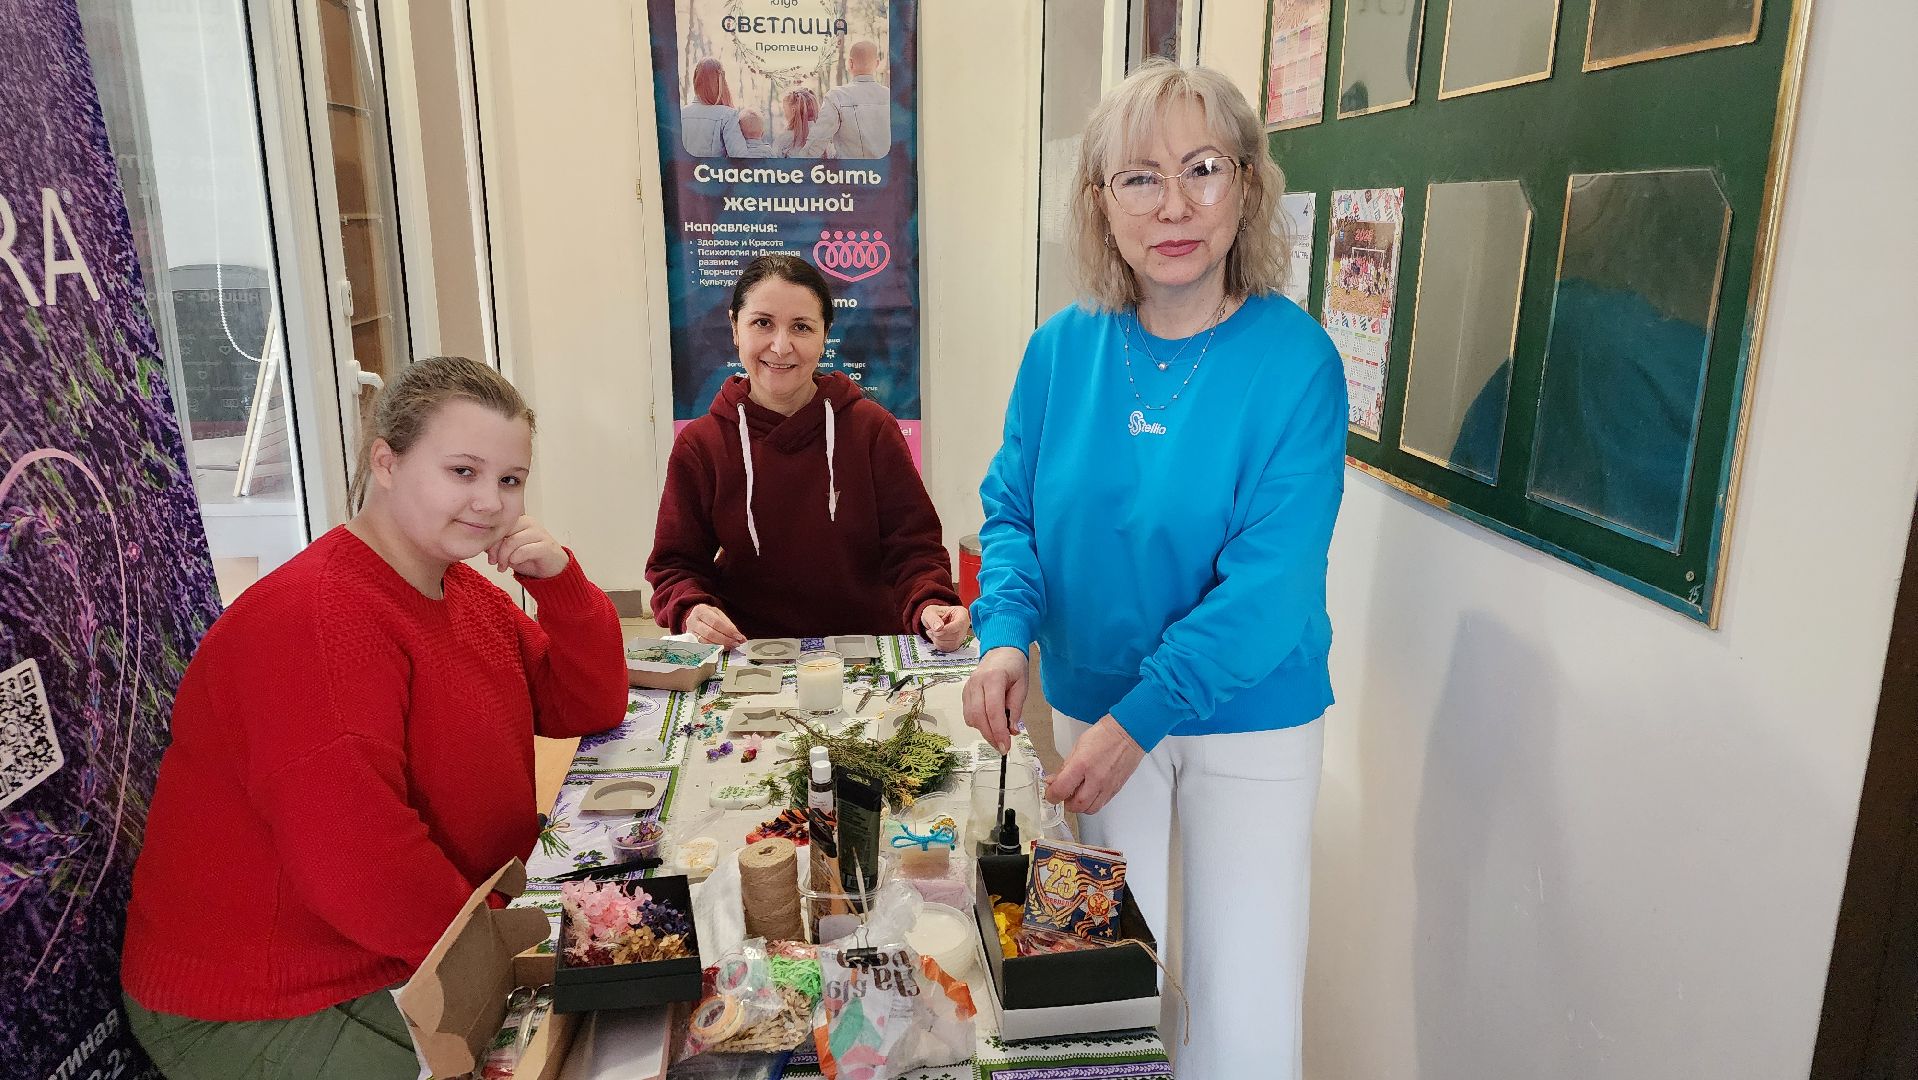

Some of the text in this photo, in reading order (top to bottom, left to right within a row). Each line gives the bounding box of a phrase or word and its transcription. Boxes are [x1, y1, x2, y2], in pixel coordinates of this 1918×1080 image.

[721, 15, 848, 37] СВЕТЛИЦА
[755, 42, 818, 53] Протвино
[693, 164, 882, 185] Счастье быть
[723, 192, 854, 214] женщиной
[684, 221, 778, 235] Направления:
[697, 238, 739, 247] Здоровье
[749, 239, 783, 247] Красота
[698, 249, 749, 257] Психология
[698, 259, 739, 267] развитие
[699, 268, 744, 277] Творчеств
[1045, 858, 1078, 900] 23
[48, 1009, 118, 1080] тиная
